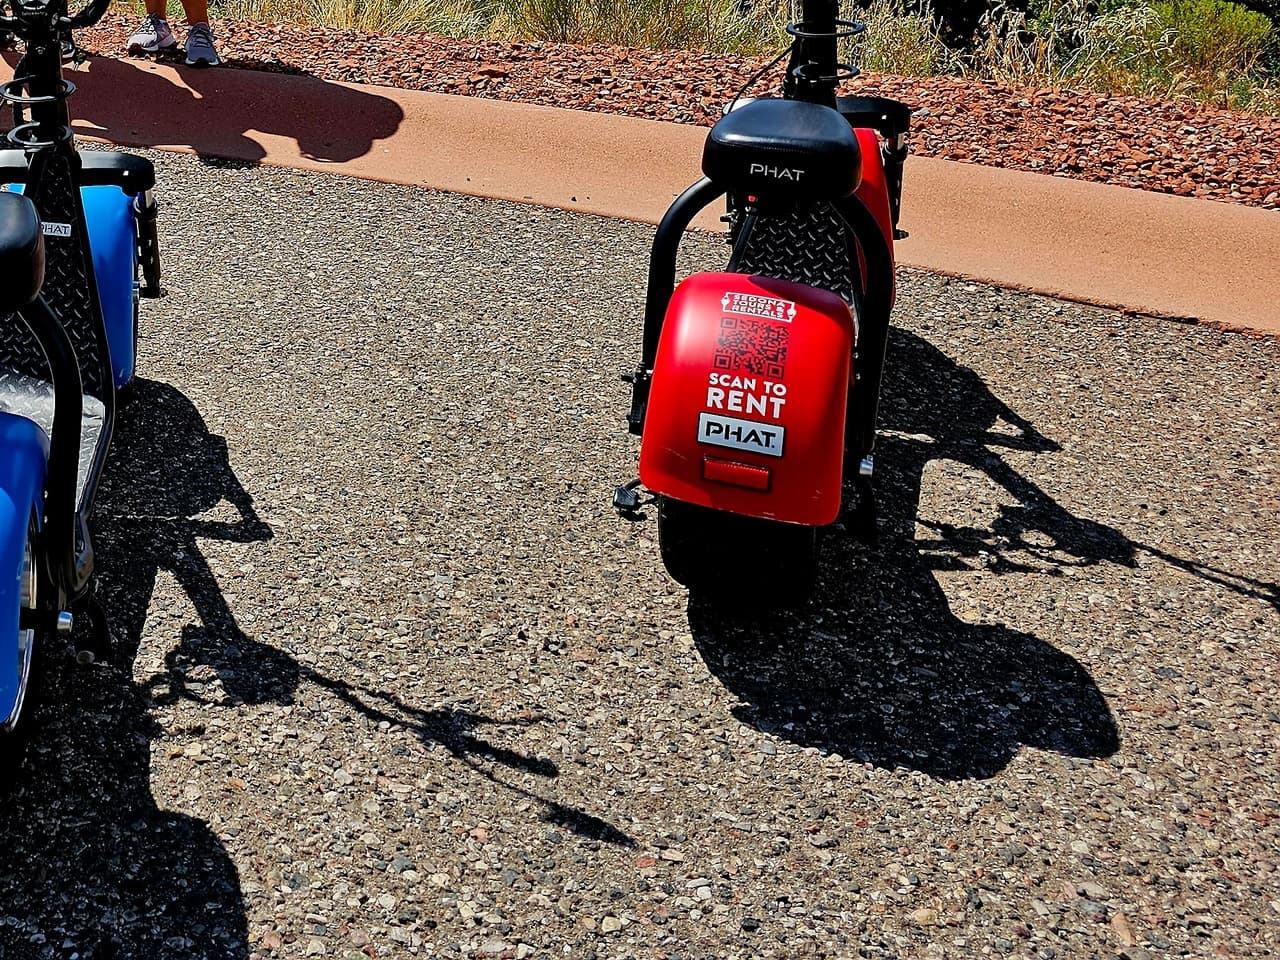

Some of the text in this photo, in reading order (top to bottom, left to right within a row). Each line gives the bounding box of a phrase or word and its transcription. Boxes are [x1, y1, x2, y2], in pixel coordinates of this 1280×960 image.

[750, 163, 805, 181] PHAT
[733, 294, 785, 307] SEDONA
[733, 299, 771, 310] TOURS
[732, 305, 784, 318] RENTALS
[709, 373, 787, 396] SCAN TO
[706, 386, 786, 418] RENT
